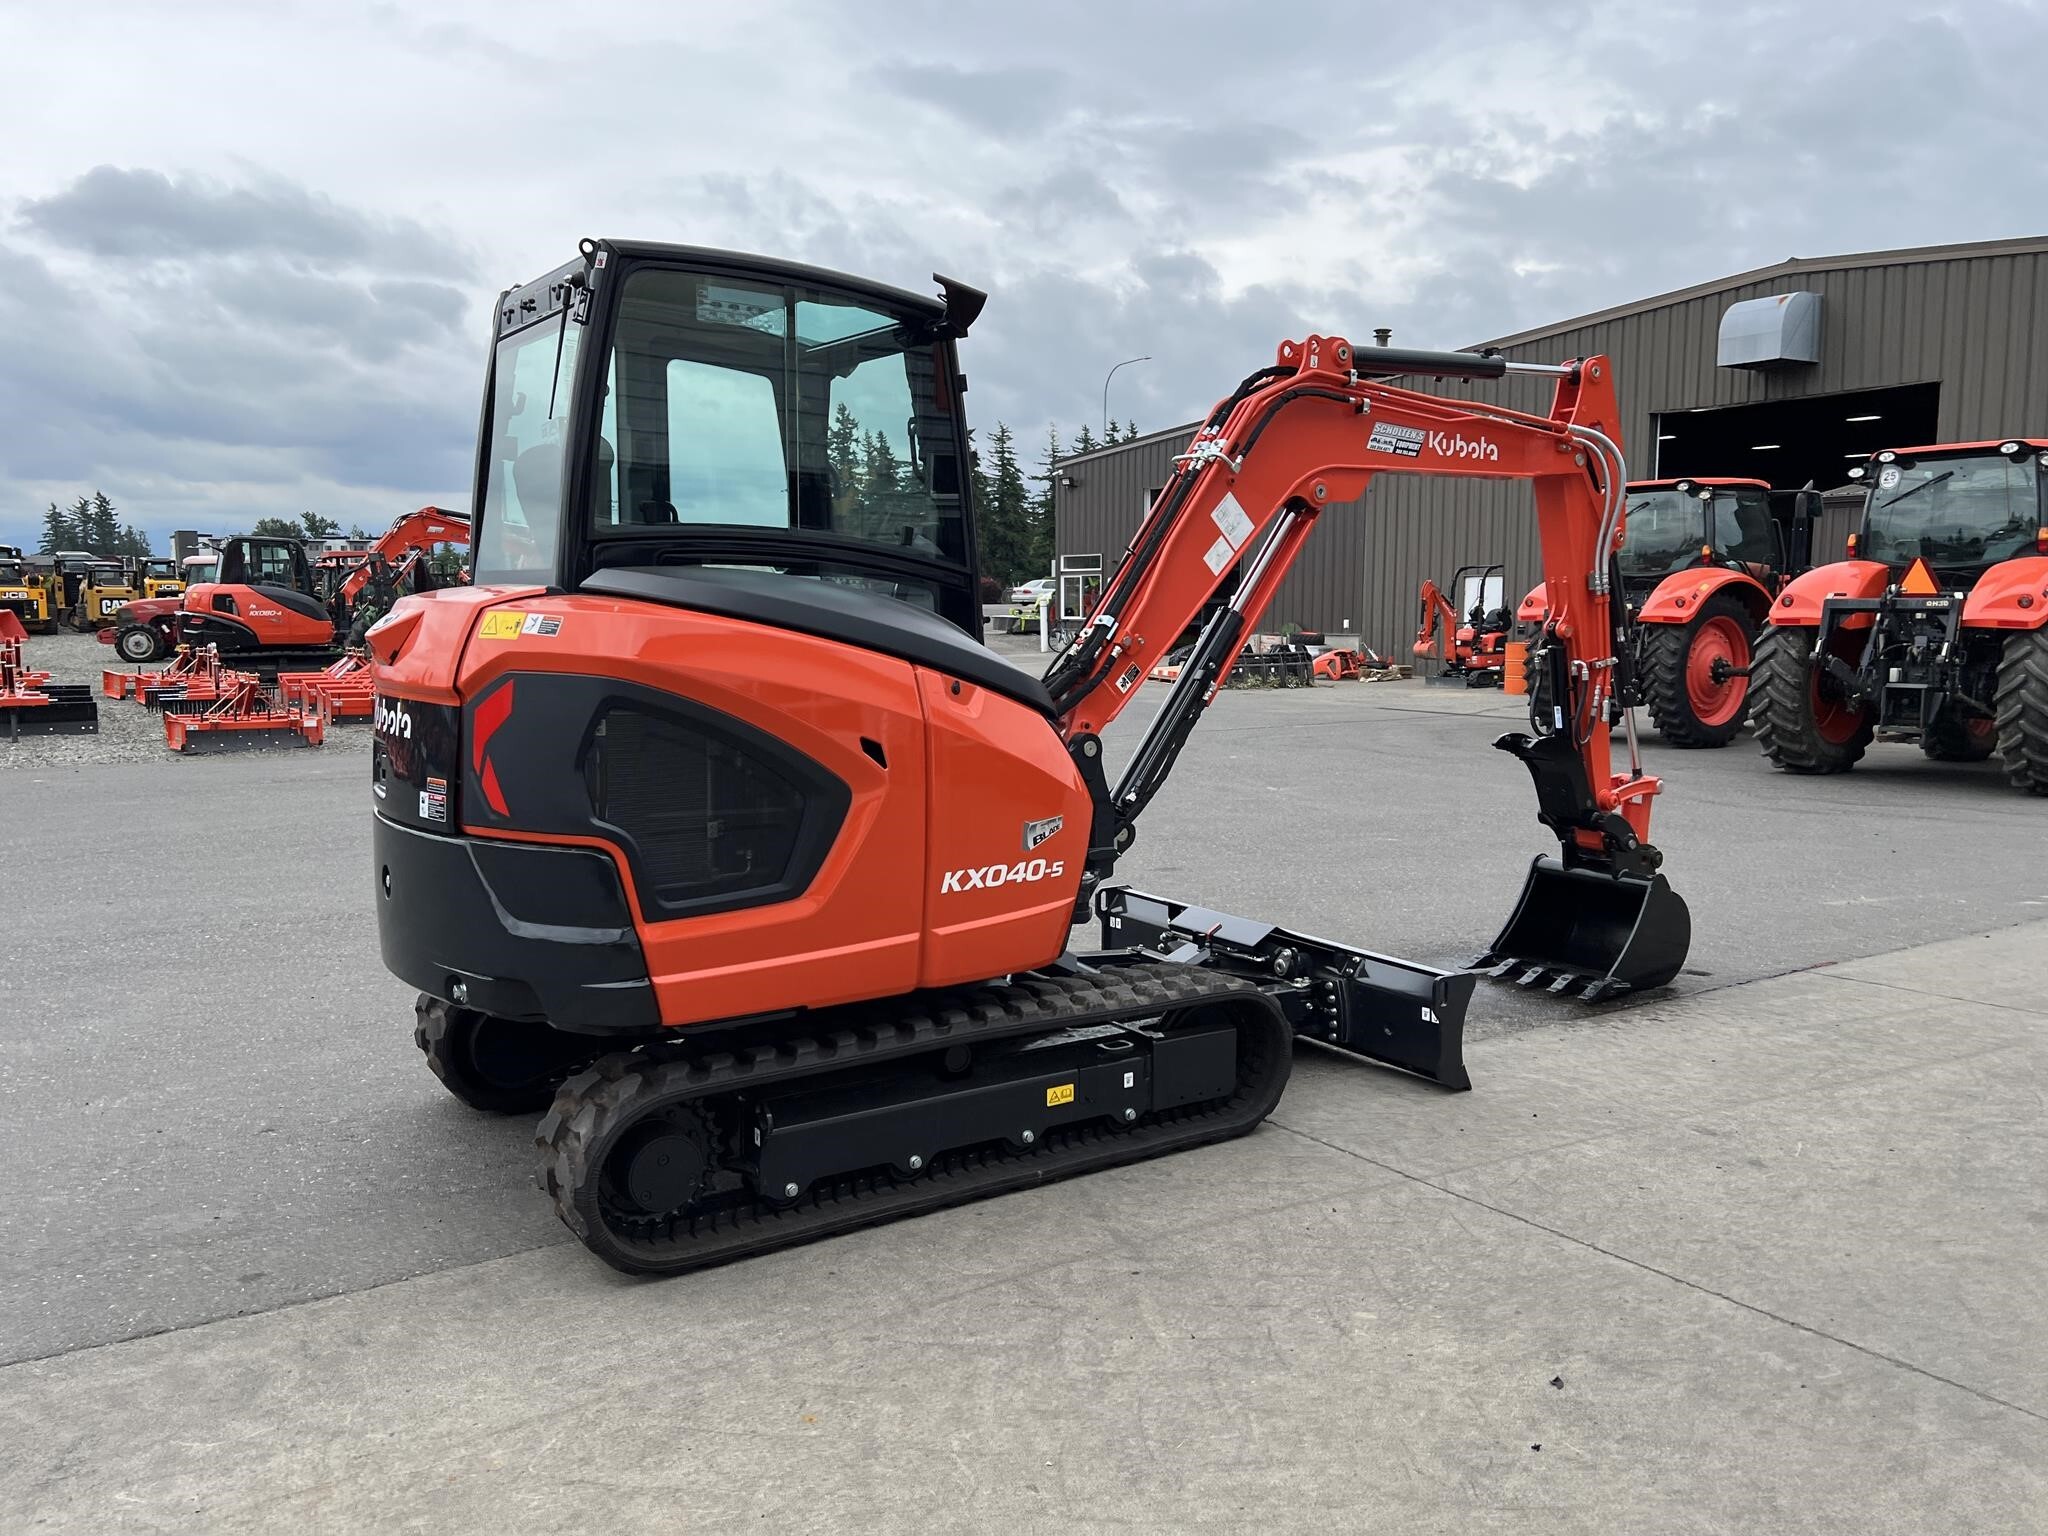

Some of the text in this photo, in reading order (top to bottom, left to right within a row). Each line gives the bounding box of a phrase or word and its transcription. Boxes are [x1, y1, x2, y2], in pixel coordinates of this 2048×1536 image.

[1428, 430, 1498, 461] Kubota
[1884, 471, 1896, 481] 25
[1, 591, 28, 599] JCB
[1032, 823, 1061, 846] BLADE
[940, 859, 1064, 894] KX040-5
